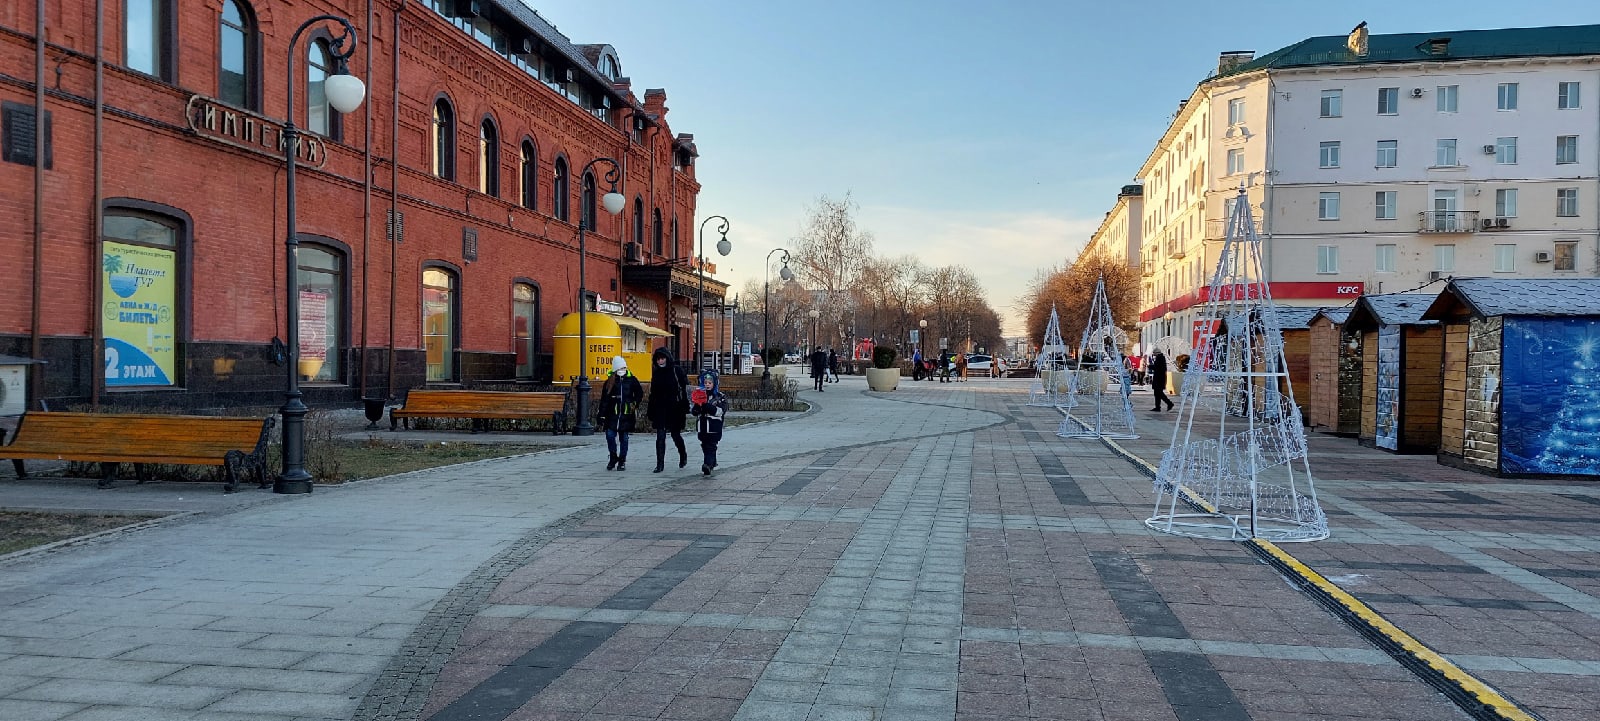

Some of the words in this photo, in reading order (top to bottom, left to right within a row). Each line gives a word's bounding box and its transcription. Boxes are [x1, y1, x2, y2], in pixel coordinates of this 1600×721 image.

[125, 263, 165, 277] Планета
[134, 277, 154, 287] ТУР
[1337, 286, 1359, 294] KFC
[119, 312, 158, 324] БИЛЕТЫ
[589, 344, 614, 352] STREET
[104, 347, 119, 379] 2
[123, 364, 156, 379] ЭТАЖ
